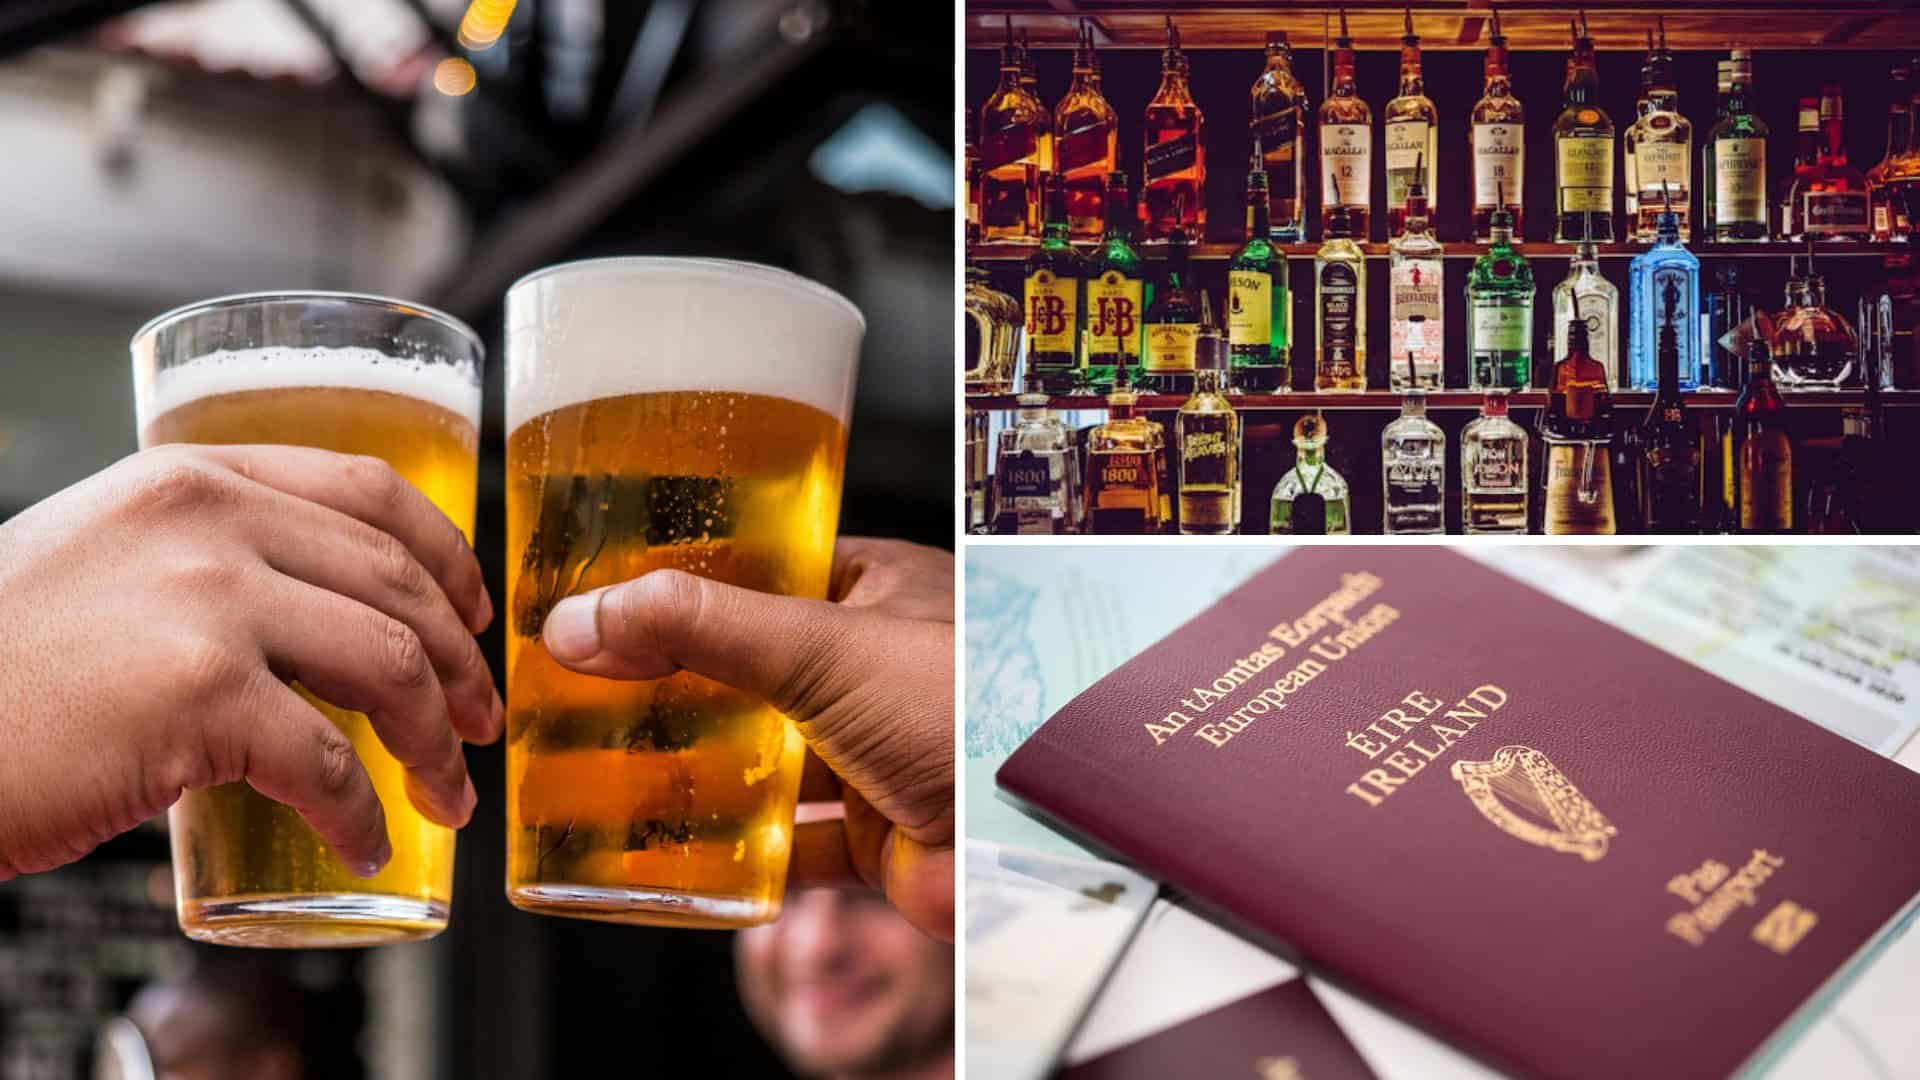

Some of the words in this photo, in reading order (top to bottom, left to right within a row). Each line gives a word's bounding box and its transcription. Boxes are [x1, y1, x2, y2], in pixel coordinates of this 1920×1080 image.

[1341, 165, 1353, 177] 12
[1028, 296, 1067, 335] J&B
[1092, 297, 1135, 337] J&B
[1008, 468, 1046, 484] 1800
[1102, 468, 1137, 482] 1800
[1144, 711, 1194, 746] An
[1181, 641, 1286, 713] tAontas
[1195, 657, 1328, 749] European
[1310, 603, 1400, 662] Union
[1346, 690, 1444, 760] ÉIRE
[1346, 684, 1508, 807] IRELAND
